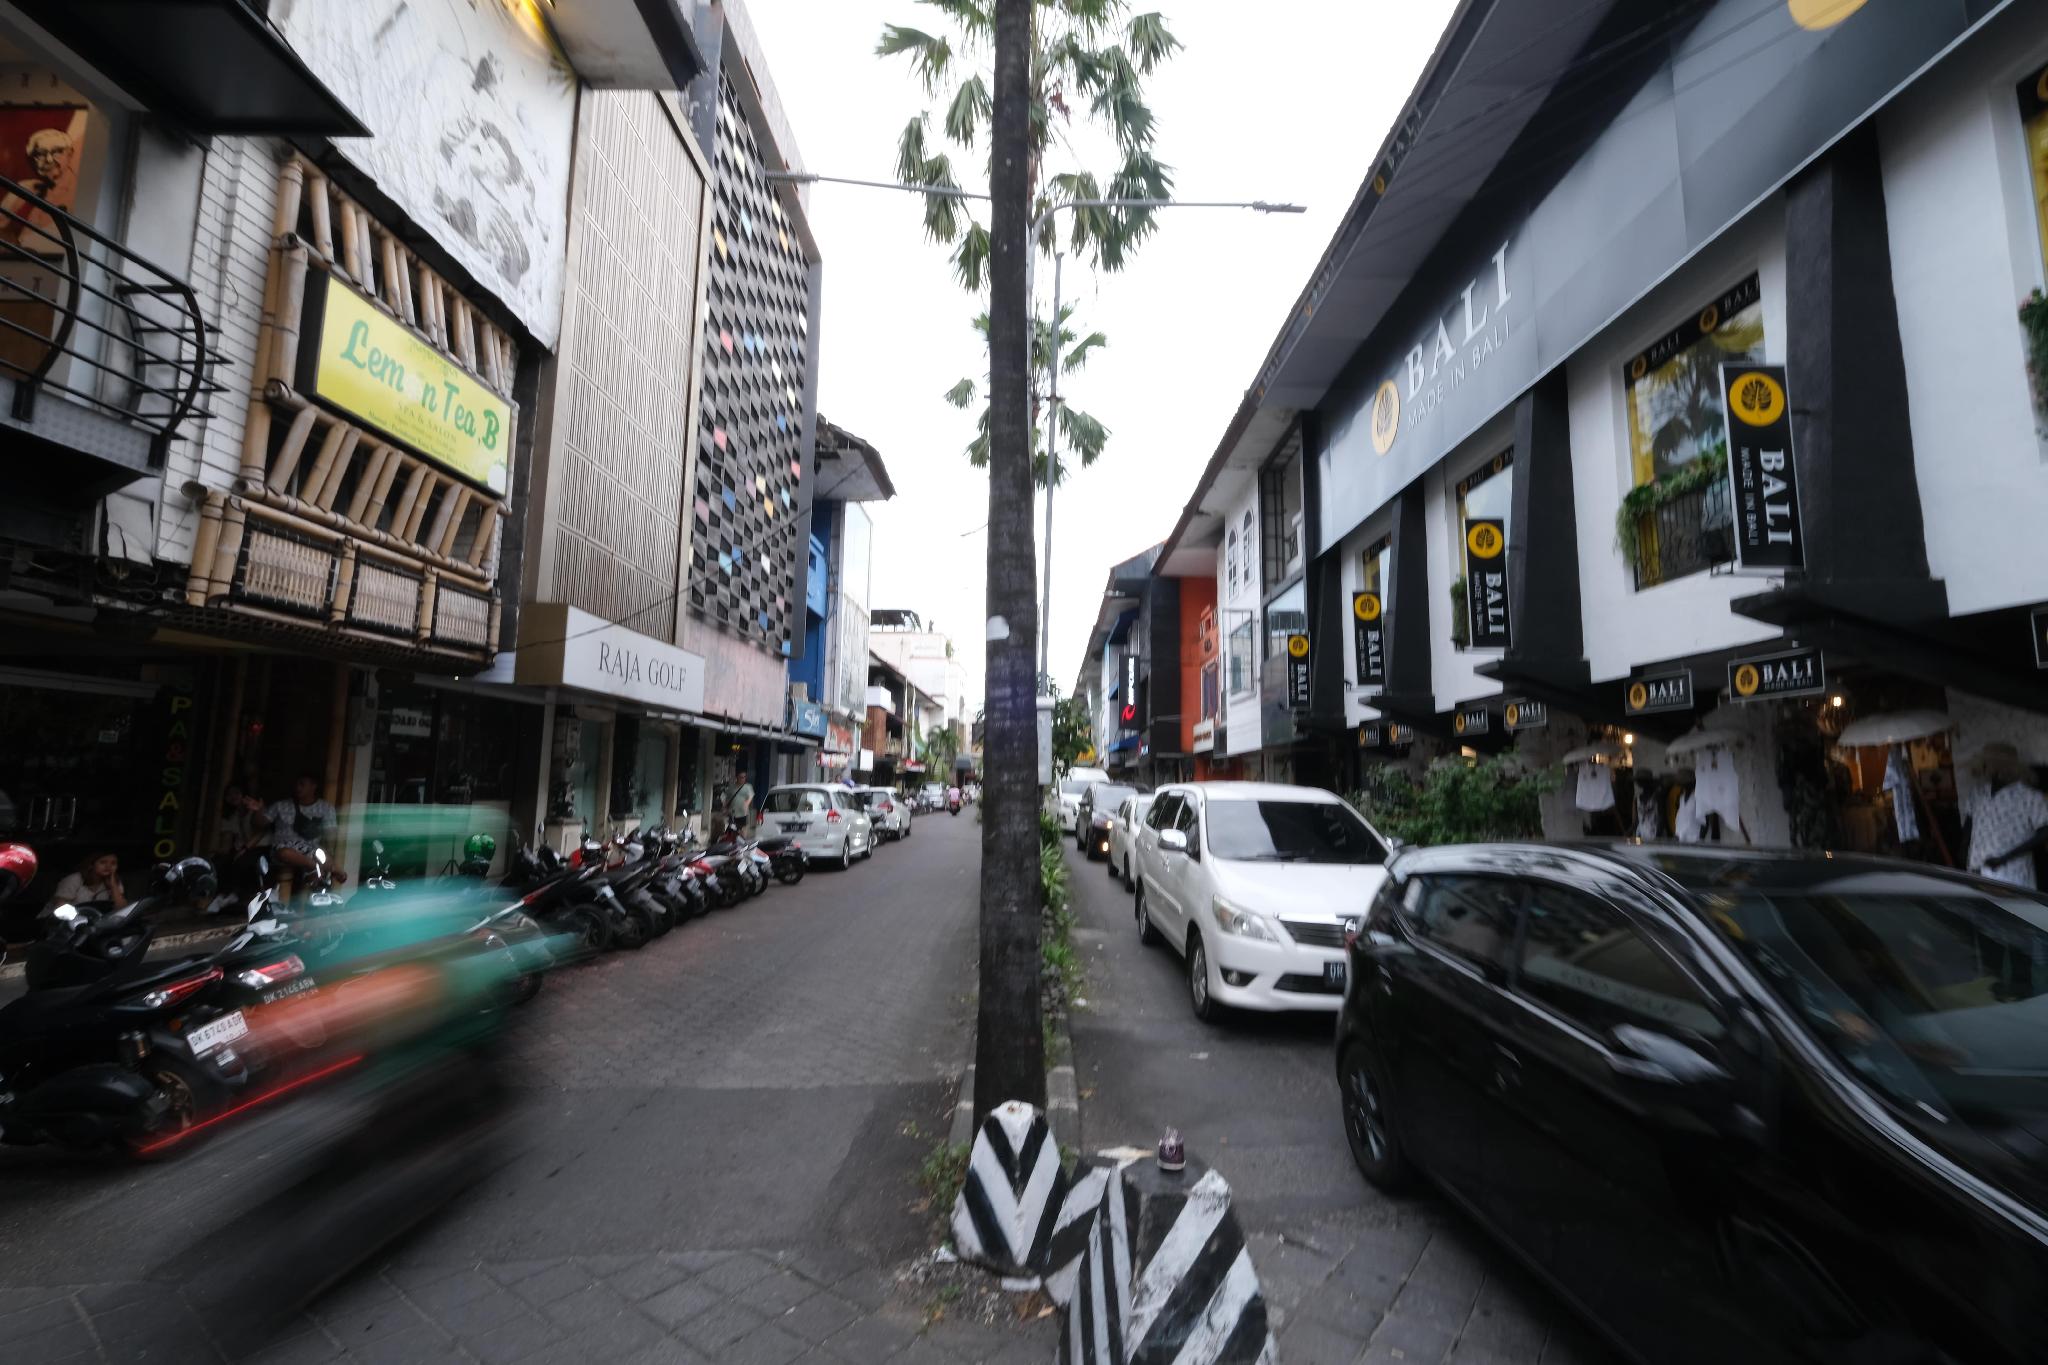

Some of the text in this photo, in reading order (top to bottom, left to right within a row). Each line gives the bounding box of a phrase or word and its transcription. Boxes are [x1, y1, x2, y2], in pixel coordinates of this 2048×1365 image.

[1724, 276, 1760, 311] BALI
[1405, 240, 1512, 404] BALI
[1651, 331, 1679, 360] BALI
[1407, 314, 1510, 432] MADE IN BALI
[1759, 448, 1793, 545] BALI
[1486, 571, 1505, 635] BALI
[598, 641, 686, 692] RAJA GOLF
[1367, 630, 1381, 676] BALI
[1763, 658, 1812, 683] BALI
[1298, 664, 1307, 701] BALI
[1649, 679, 1683, 699] BALI
[1465, 711, 1484, 726] BALI
[1519, 702, 1541, 718] BALI
